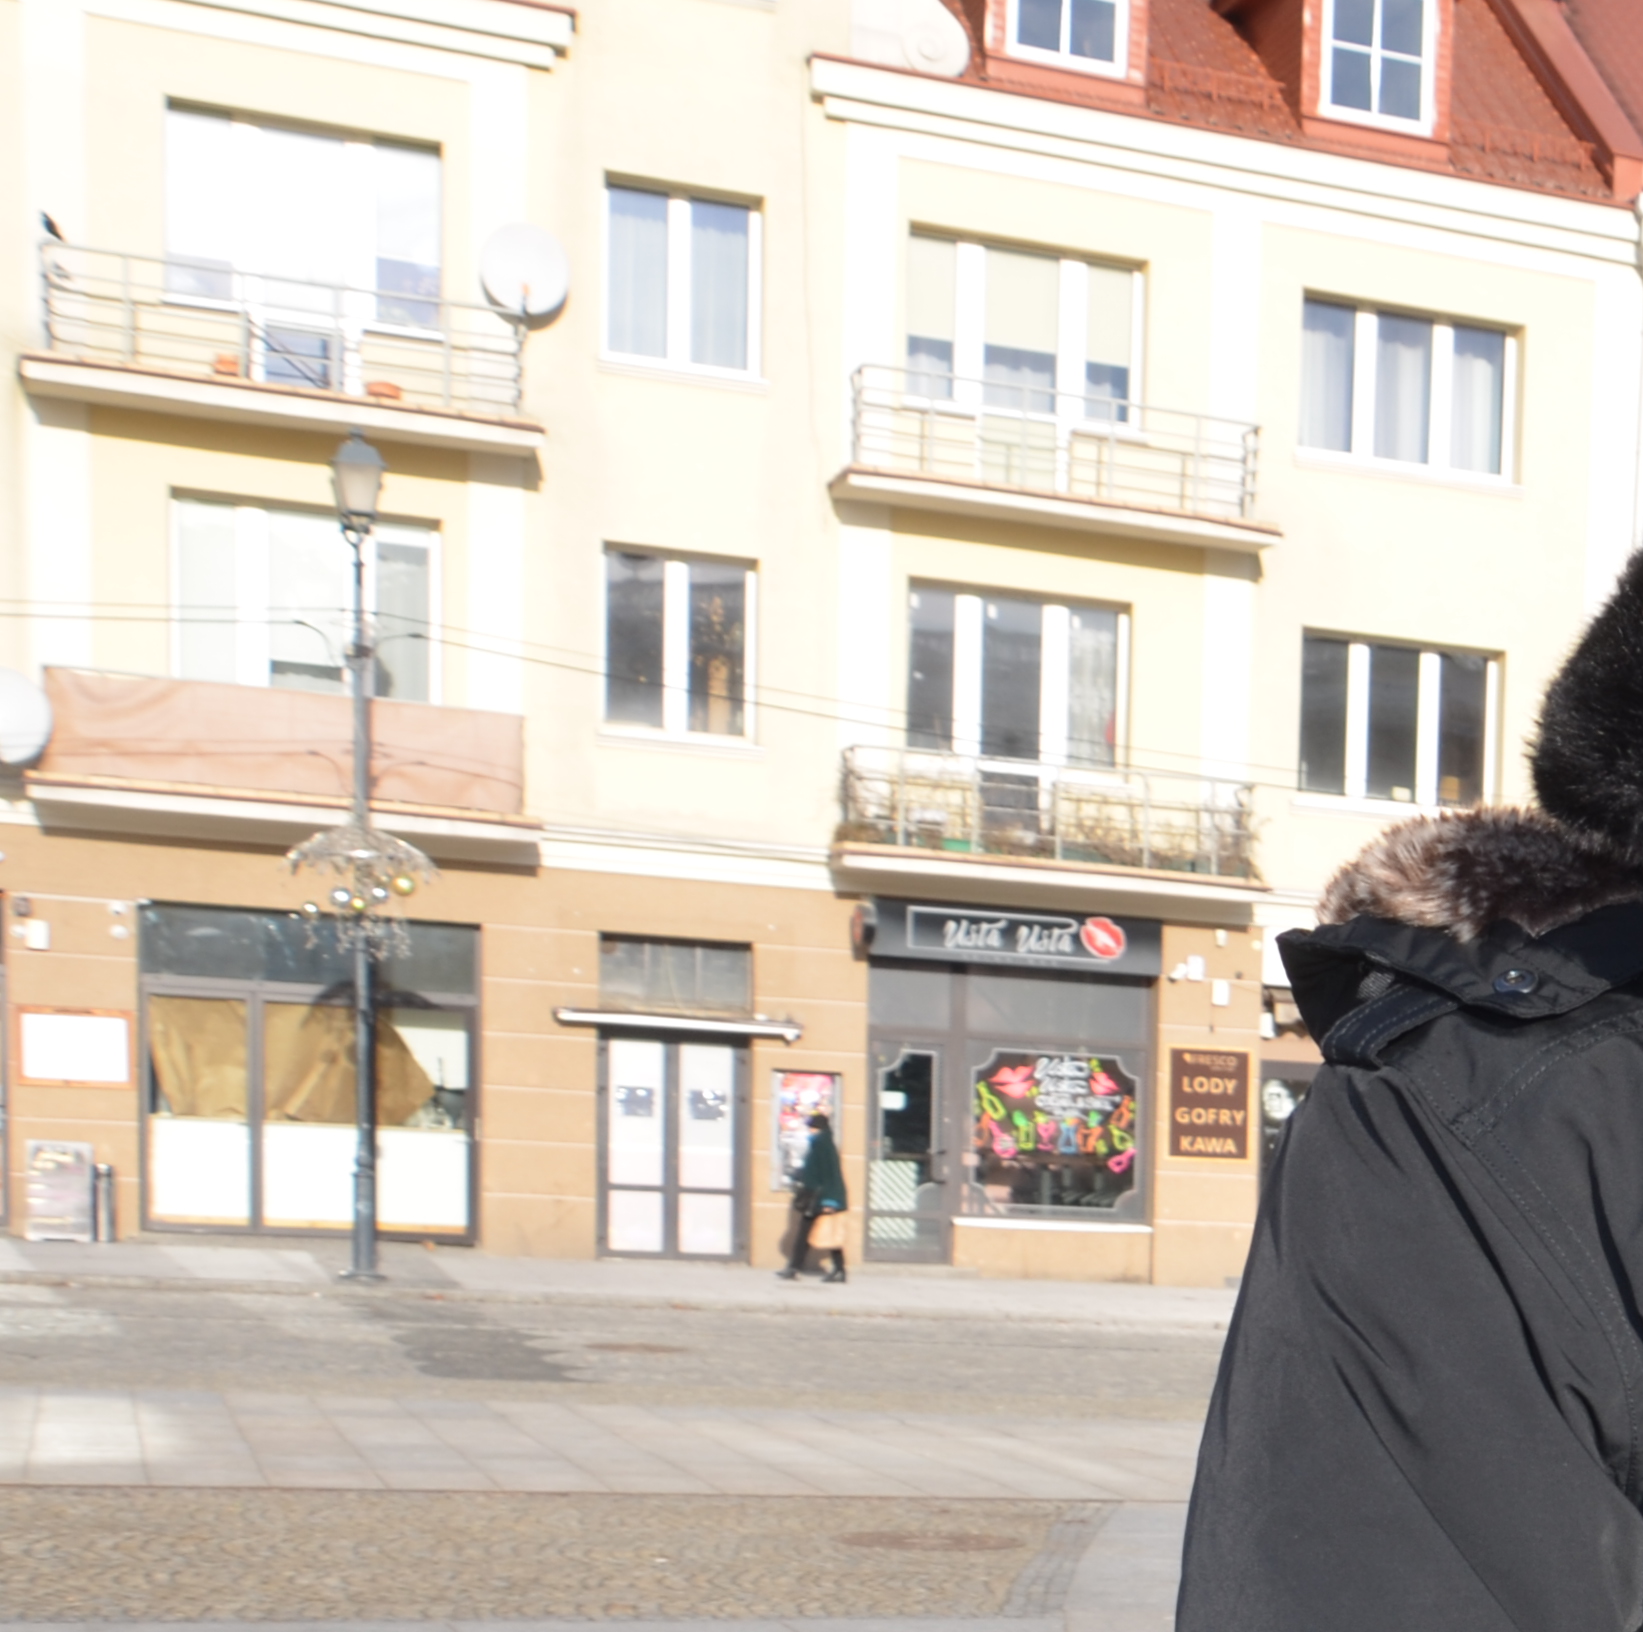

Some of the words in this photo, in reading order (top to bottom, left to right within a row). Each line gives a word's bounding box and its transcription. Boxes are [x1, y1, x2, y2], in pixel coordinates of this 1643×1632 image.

[1182, 1076, 1237, 1096] LODY
[1174, 1106, 1246, 1127] GOFRY
[1179, 1135, 1238, 1155] KAWA
